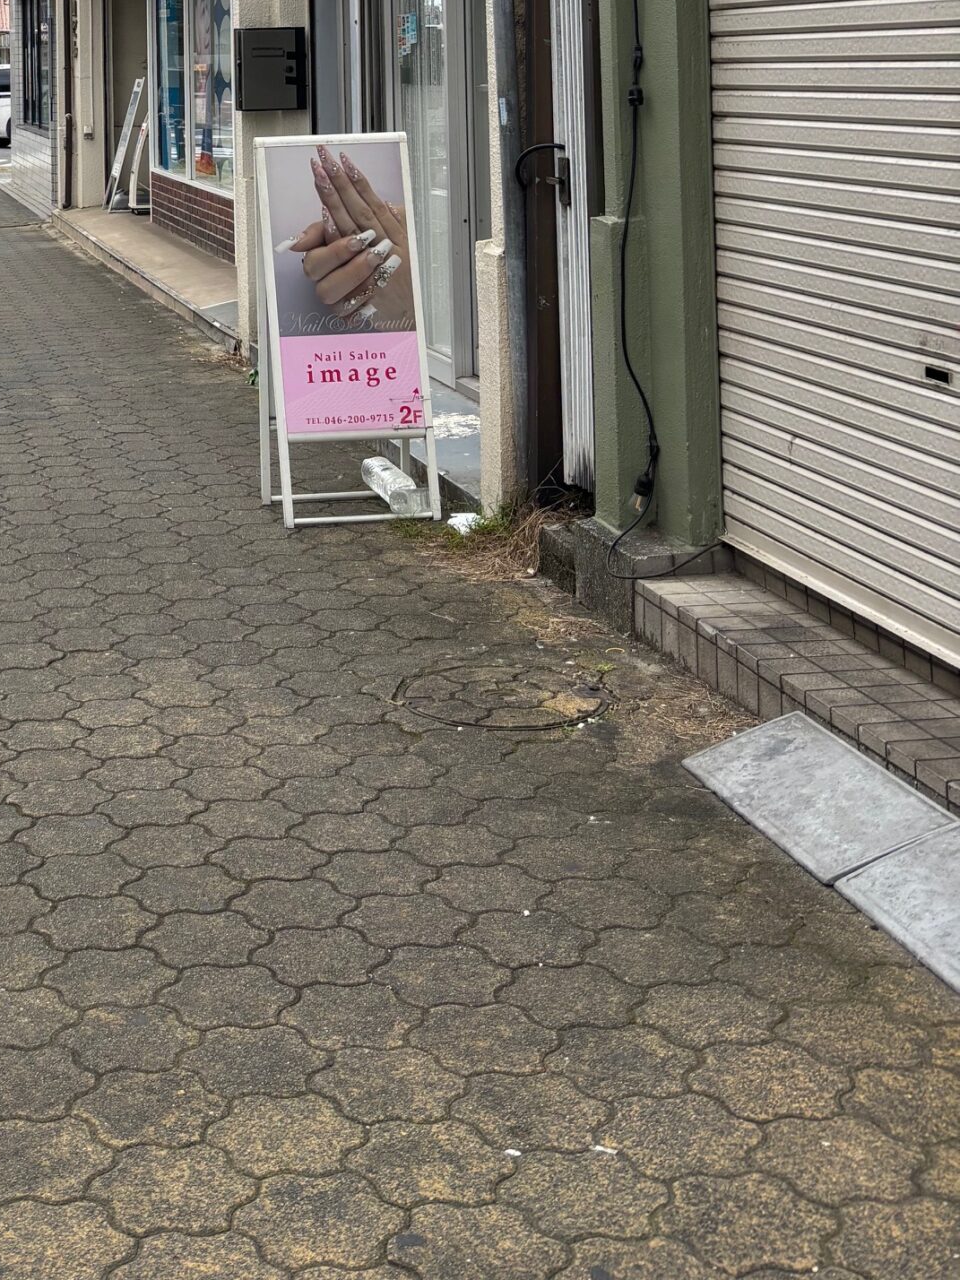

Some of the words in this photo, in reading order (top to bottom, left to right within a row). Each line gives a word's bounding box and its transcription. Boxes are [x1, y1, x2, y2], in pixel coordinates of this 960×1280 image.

[314, 351, 342, 361] Nail
[349, 350, 386, 360] Salon
[307, 364, 397, 387] image
[400, 405, 423, 424] 2F
